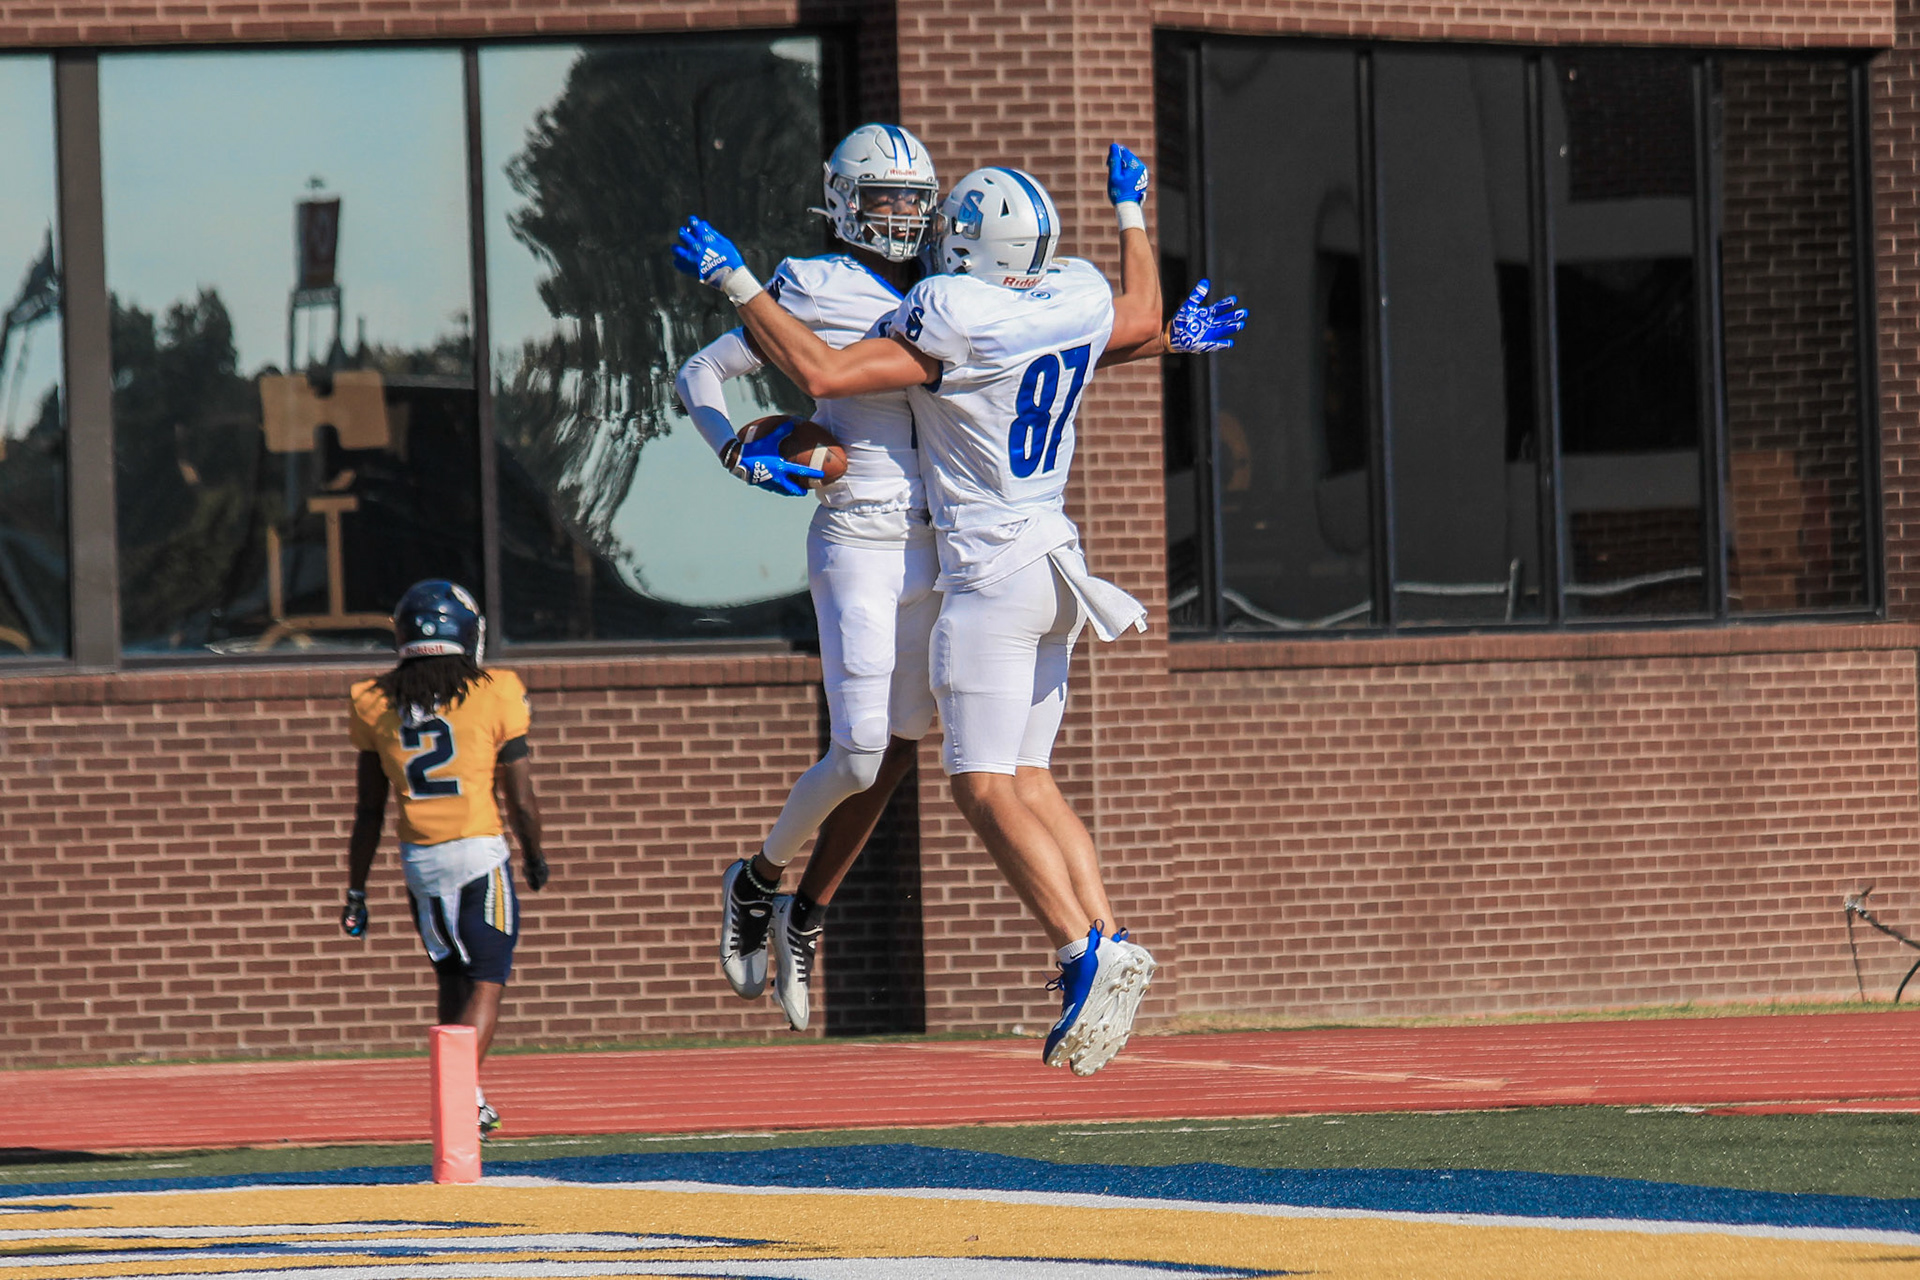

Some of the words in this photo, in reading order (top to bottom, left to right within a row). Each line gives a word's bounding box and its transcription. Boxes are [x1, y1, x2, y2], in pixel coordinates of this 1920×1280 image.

[700, 255, 727, 275] adidas
[1003, 276, 1041, 288] Ridd
[1008, 343, 1092, 479] 87
[400, 714, 463, 800] 2
